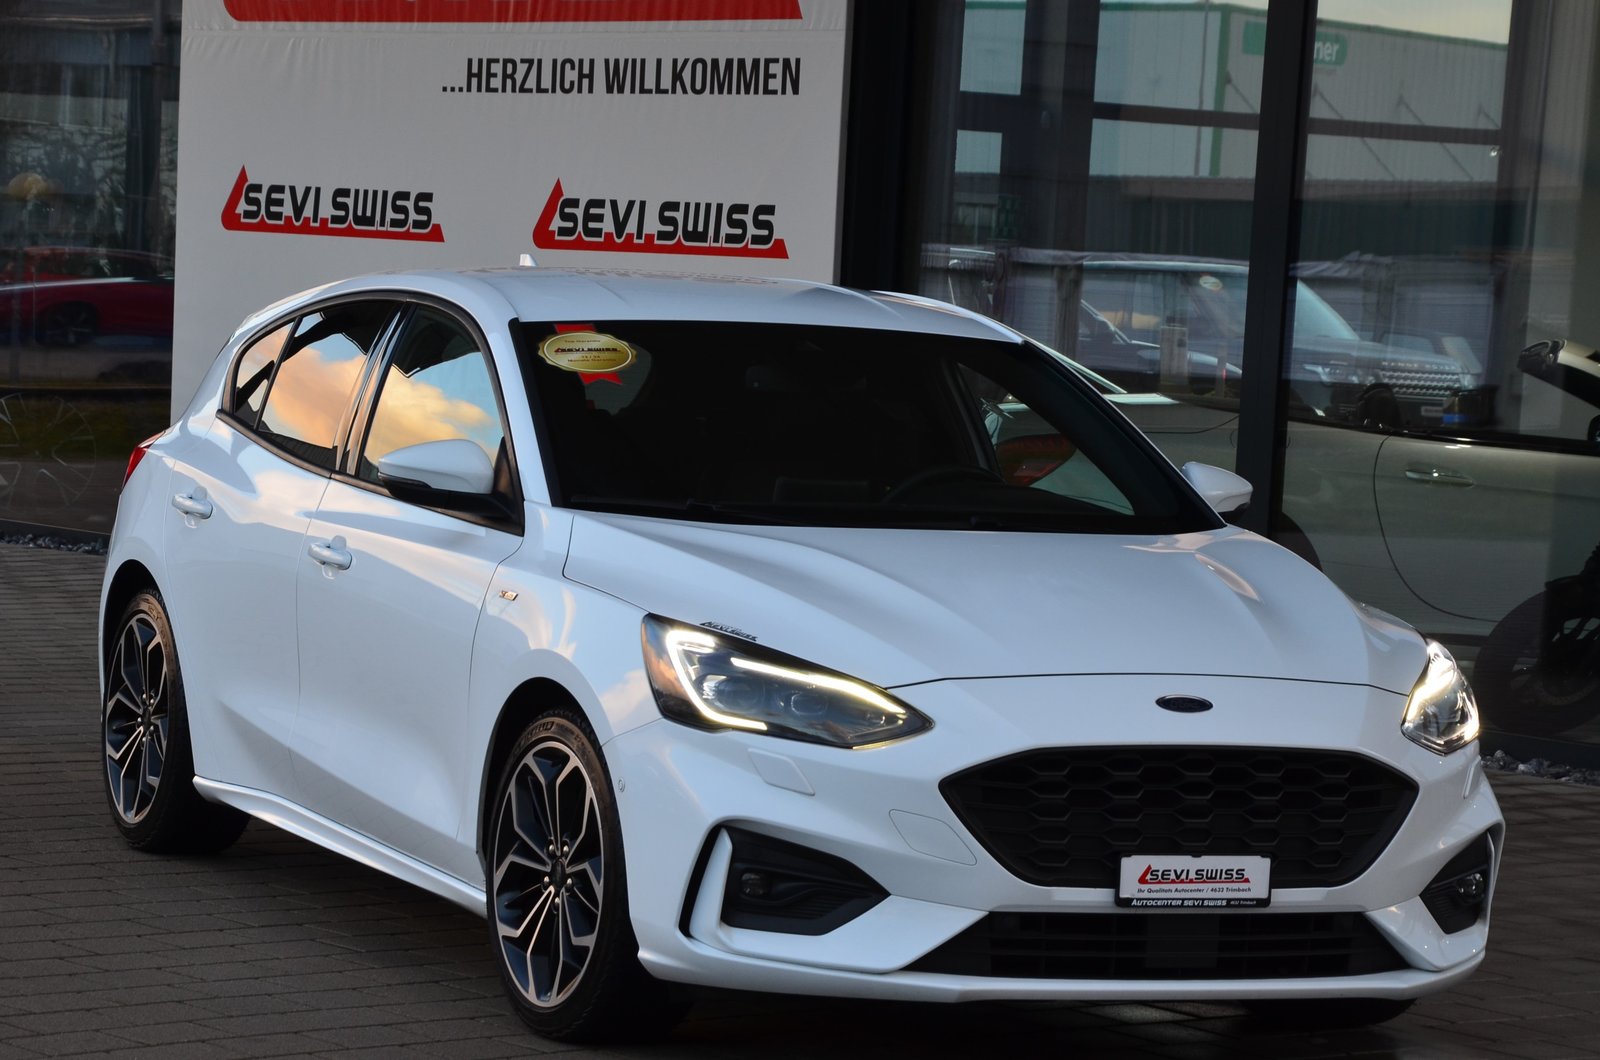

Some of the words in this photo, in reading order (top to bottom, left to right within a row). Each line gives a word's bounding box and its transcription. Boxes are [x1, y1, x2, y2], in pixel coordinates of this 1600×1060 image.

[1313, 41, 1339, 61] ner
[442, 57, 595, 95] ...HERZLICH
[604, 57, 801, 96] WILLKOMMEN
[243, 183, 321, 226] SEVI
[331, 187, 434, 230] SWISS
[556, 197, 647, 243] SEVI
[656, 201, 776, 246] SWISS
[1149, 869, 1190, 881] SEVI
[1195, 868, 1246, 881] SWISS
